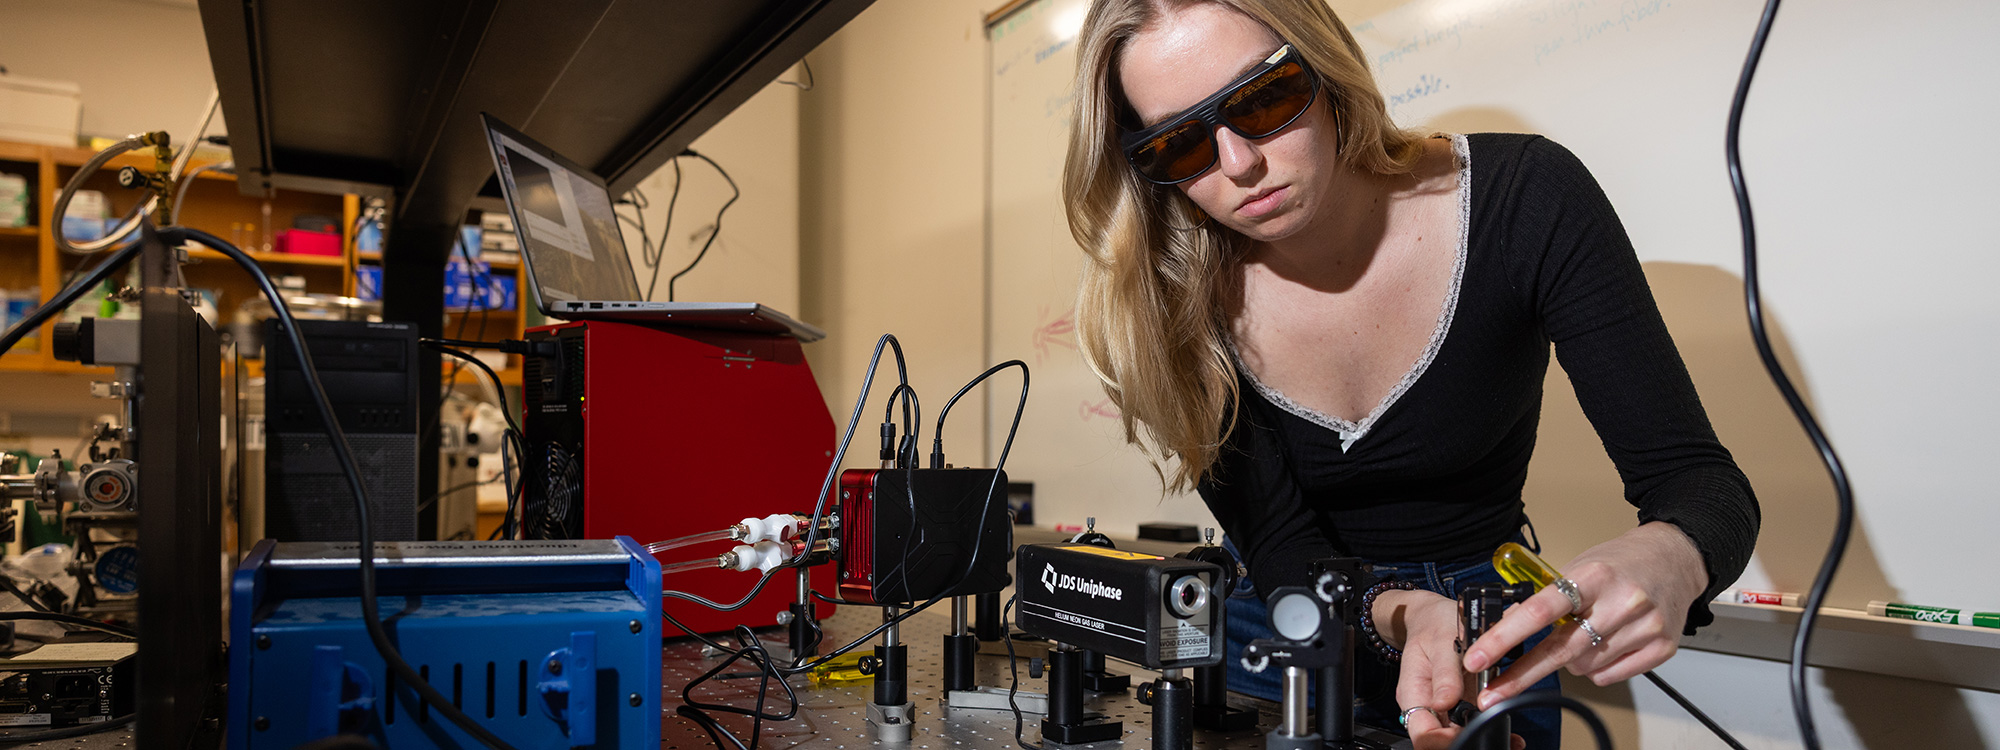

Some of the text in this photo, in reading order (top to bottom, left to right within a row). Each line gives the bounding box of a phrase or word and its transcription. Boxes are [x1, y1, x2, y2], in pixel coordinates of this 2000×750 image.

[1058, 574, 1122, 601] JDS Uniphase
[1054, 611, 1105, 630] HELIUM NEON GAS LASER
[1915, 609, 1955, 623] EXPO
[1177, 638, 1208, 646] EXPOSURE
